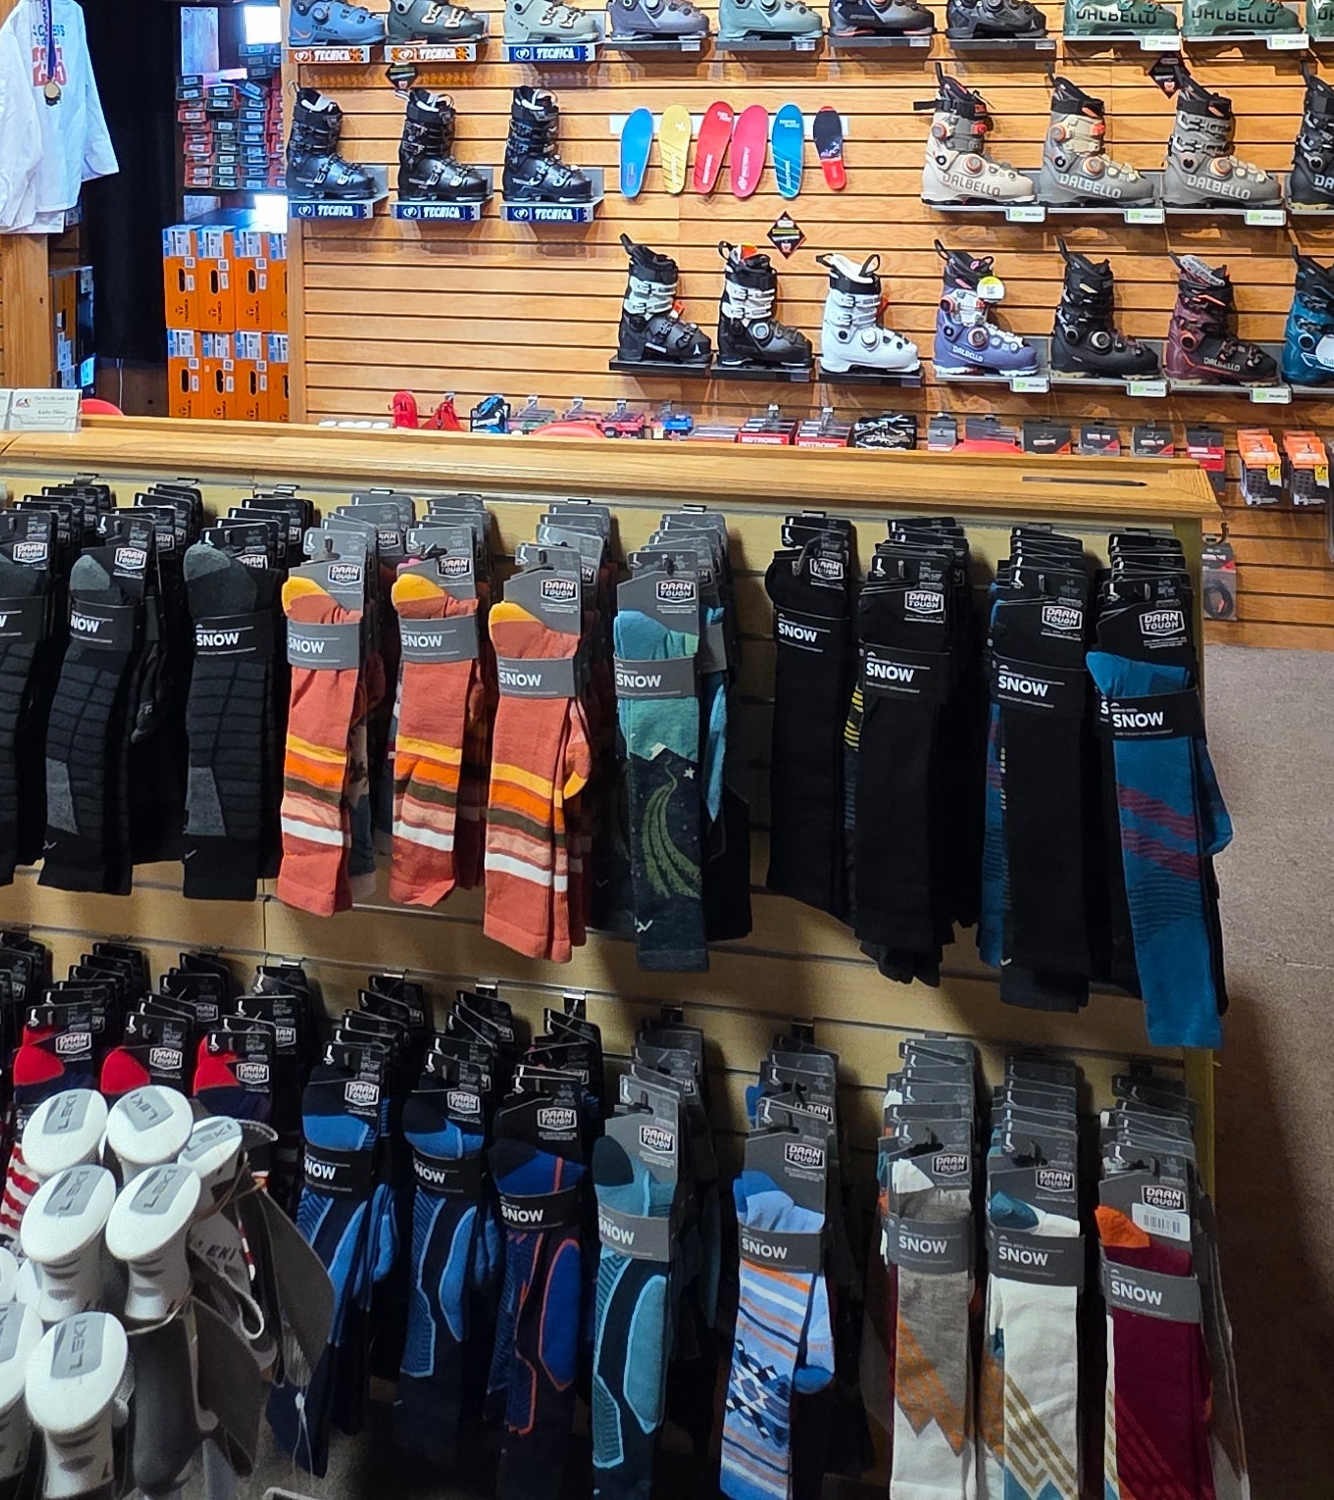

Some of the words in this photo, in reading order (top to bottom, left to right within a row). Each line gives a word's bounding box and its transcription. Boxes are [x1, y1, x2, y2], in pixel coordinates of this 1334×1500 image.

[311, 25, 339, 35] TECNICA
[314, 50, 351, 61] TECNICA
[419, 48, 457, 60] TECNICA
[536, 48, 574, 60] TECNICA
[942, 173, 1001, 196] DALBELLO
[1059, 174, 1122, 198] DALBELLO
[1187, 174, 1251, 200] DALBELLO
[317, 205, 354, 217] TECNICA
[423, 206, 461, 218] TECNICA
[535, 208, 573, 220] TECNICA
[543, 581, 576, 591] DARN
[659, 581, 693, 591] DARN
[542, 589, 576, 599] TOUGH
[659, 589, 693, 599] TOUGH
[908, 592, 942, 603] DARN
[908, 600, 942, 611] TOUGH
[1044, 607, 1082, 619] DARN
[1145, 612, 1182, 624] DARN
[1045, 616, 1081, 627] TOUGH
[1144, 621, 1183, 633] TOUGH
[778, 622, 818, 643] SNOW
[196, 632, 240, 647] SNOW
[402, 635, 443, 648] SNOW
[288, 640, 326, 654] SNOW
[866, 662, 915, 683] SNOW
[499, 673, 542, 687] SNOW
[616, 673, 662, 688] SNOW
[998, 675, 1049, 697] SNOW
[1113, 712, 1165, 729] SNOW
[57, 1093, 80, 1131] LEKI
[133, 1092, 160, 1121] LEKI
[539, 1109, 576, 1121] DARN
[185, 1121, 234, 1153] LEKI
[787, 1145, 823, 1157] DARN
[788, 1154, 821, 1166] TOUGH
[935, 1157, 967, 1168] DARN
[1040, 1171, 1075, 1182] DARN
[58, 1172, 91, 1216] LEKI
[144, 1169, 178, 1209] LEKI
[1145, 1188, 1183, 1200] DARN
[1146, 1196, 1184, 1209] TOUGH
[501, 1204, 544, 1223] SNOW
[741, 1238, 788, 1259] SNOW
[898, 1236, 948, 1255] SNOW
[998, 1247, 1048, 1266] SNOW
[1111, 1280, 1163, 1305] SNOW
[68, 1318, 91, 1372] LEKI
